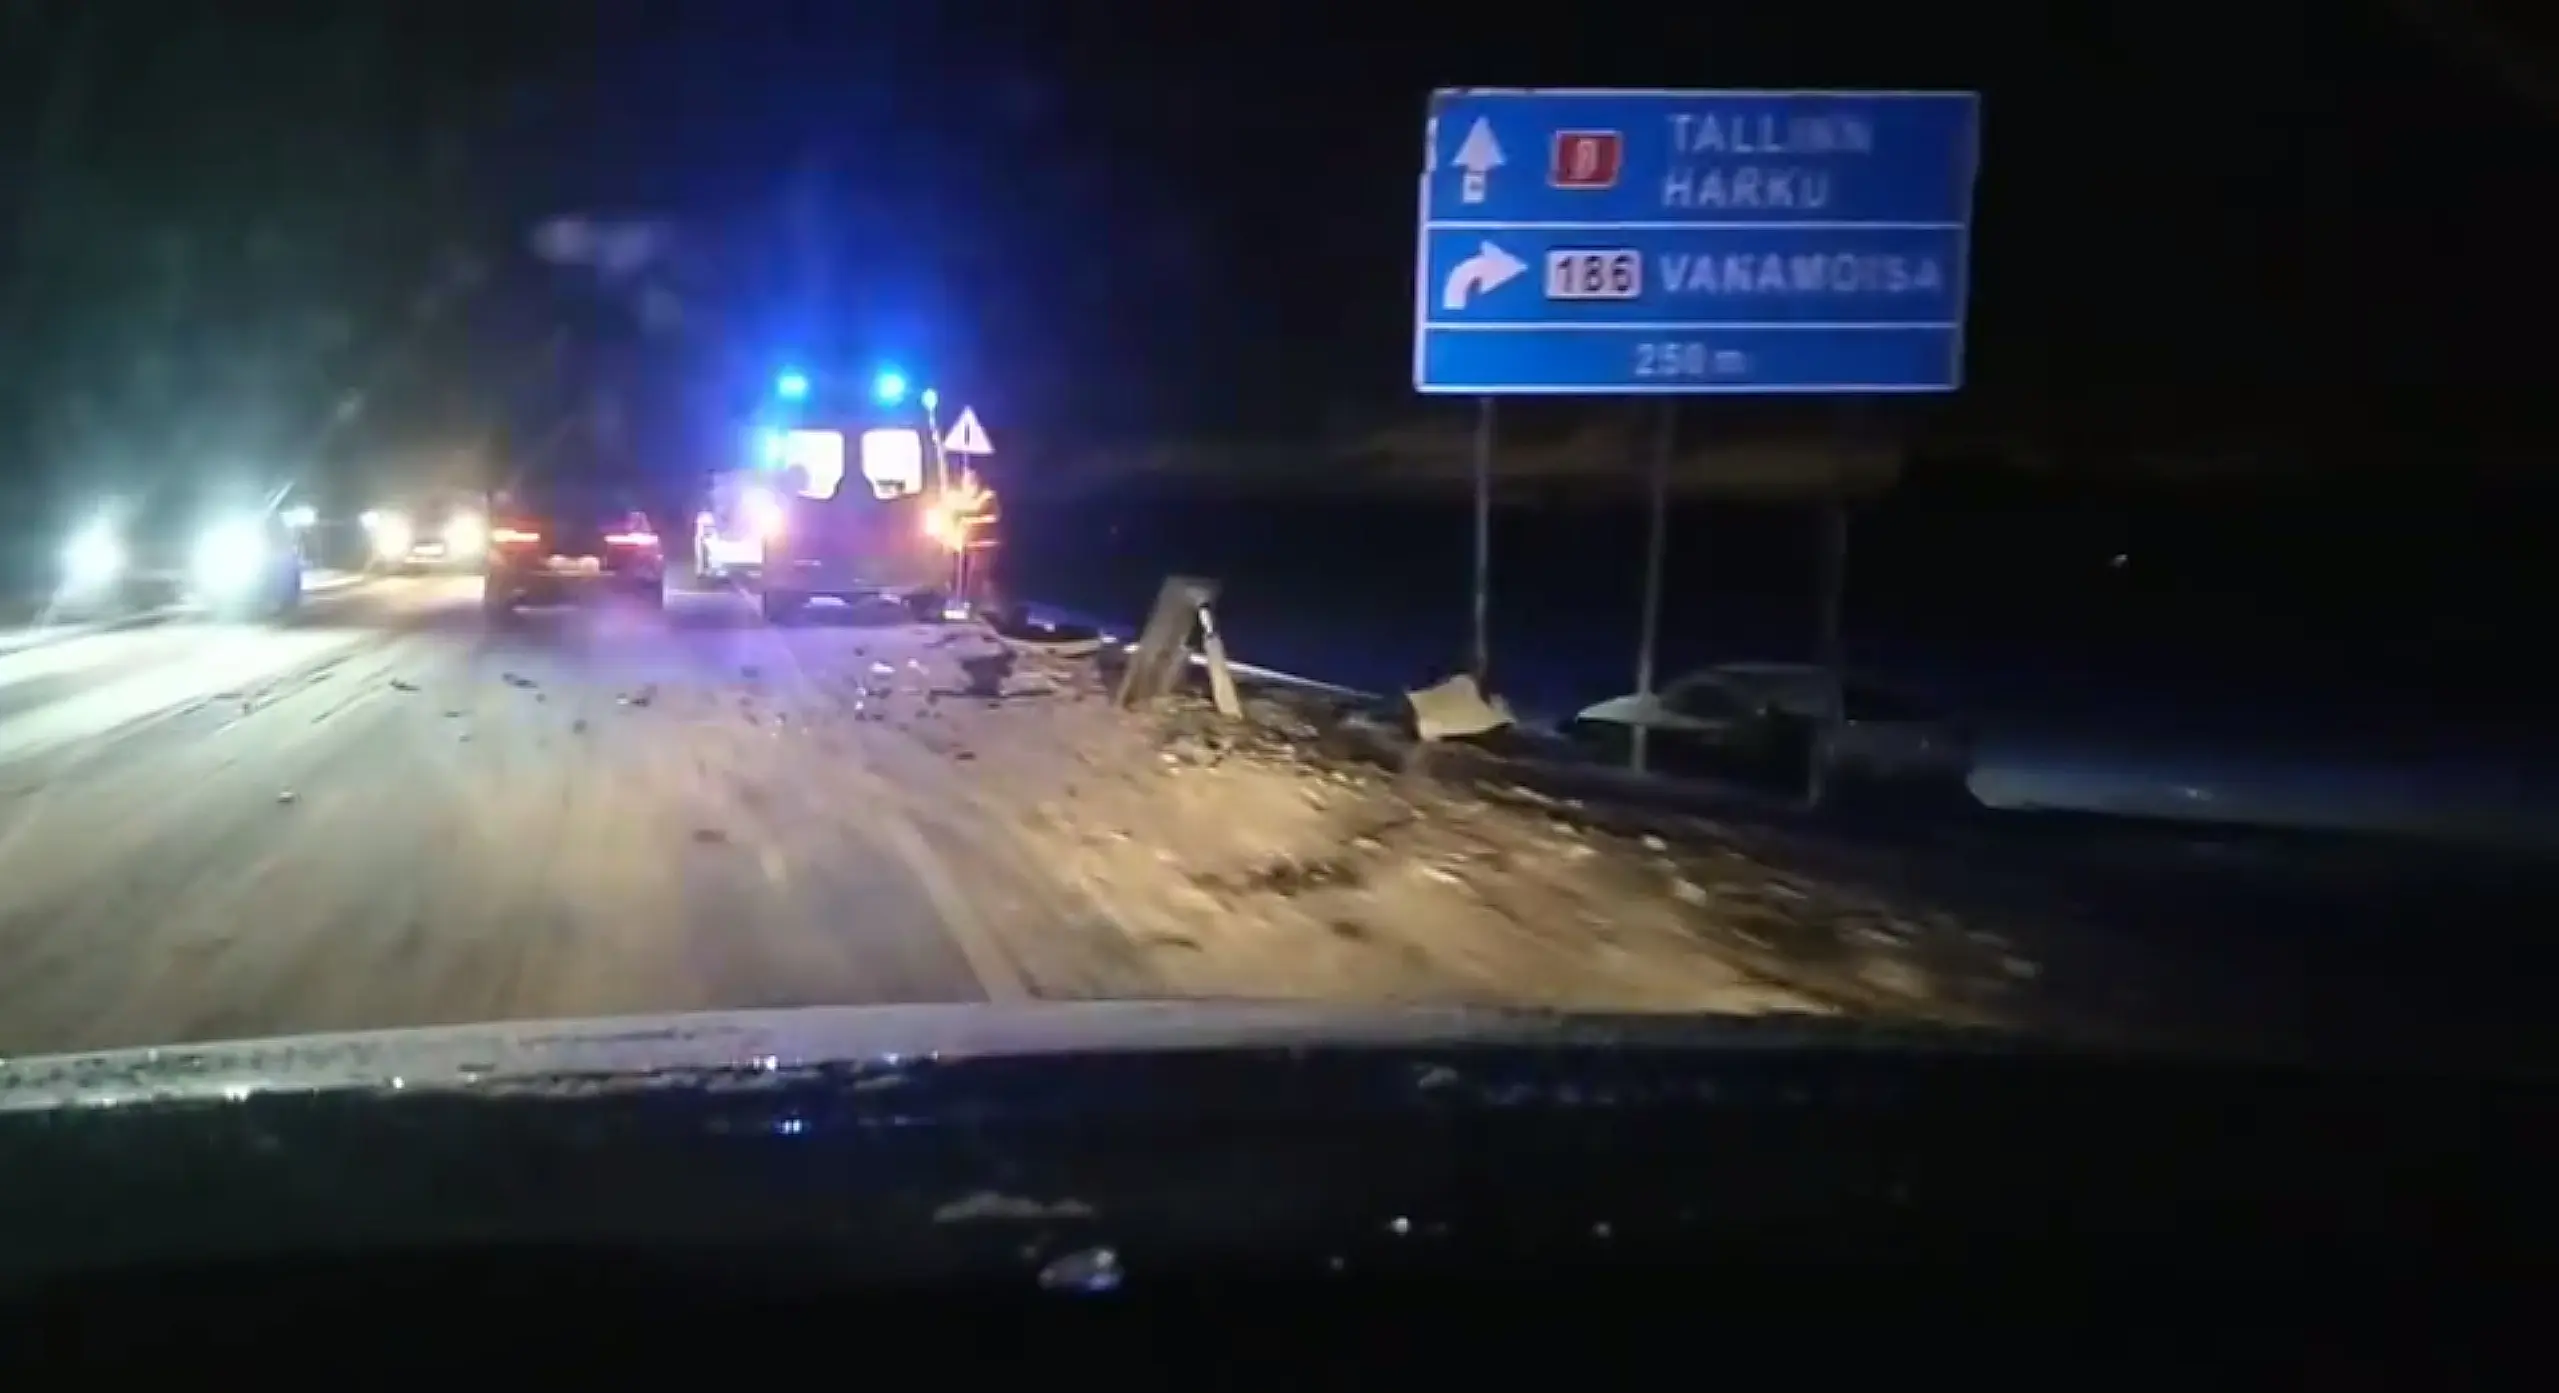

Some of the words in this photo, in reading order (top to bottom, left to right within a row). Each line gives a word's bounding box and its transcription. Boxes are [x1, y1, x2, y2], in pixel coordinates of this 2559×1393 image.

[1661, 167, 1830, 207] HARKU
[1557, 255, 1633, 292] 186
[1635, 343, 1706, 376] 250
